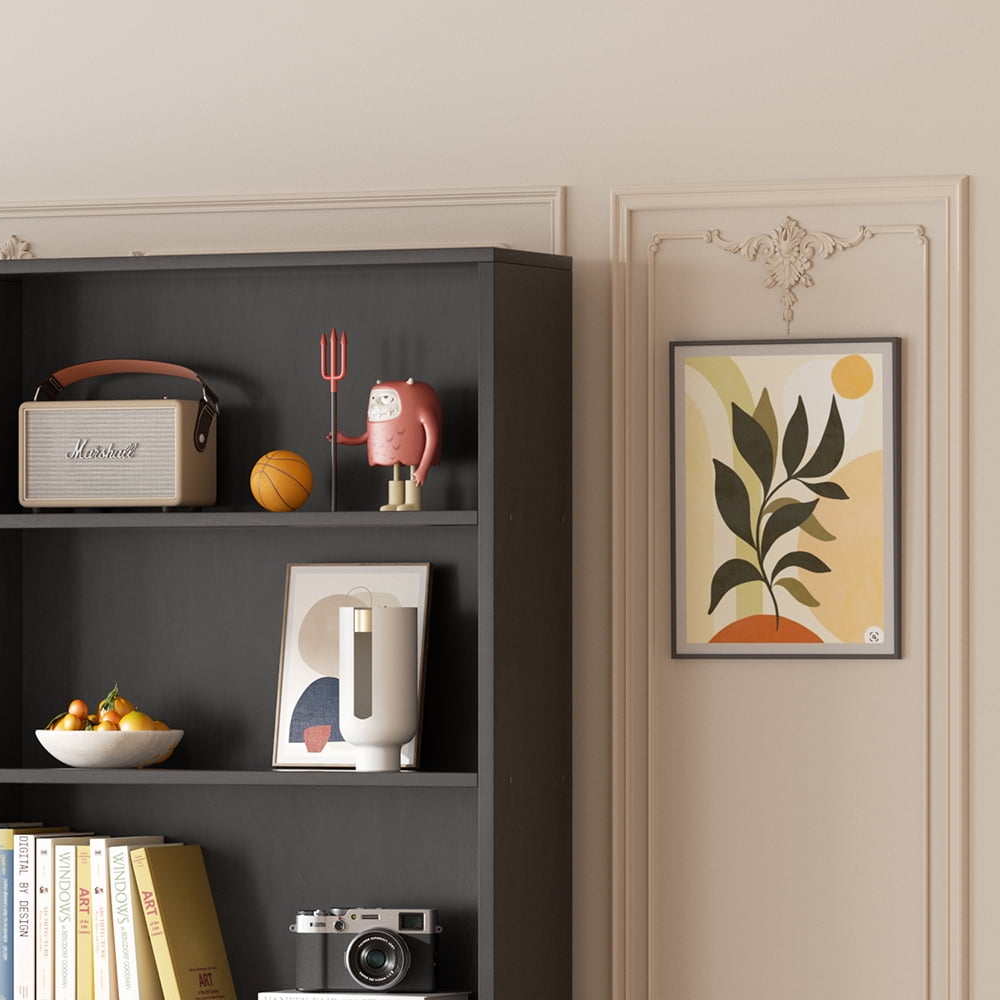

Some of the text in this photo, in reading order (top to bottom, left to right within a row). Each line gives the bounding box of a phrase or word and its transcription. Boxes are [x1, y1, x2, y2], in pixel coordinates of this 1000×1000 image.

[65, 438, 139, 460] Marshall
[18, 835, 29, 938] DIGITAL BY DESIGN
[58, 851, 71, 923] WINDOWS
[112, 852, 130, 925] WINDOWS
[79, 888, 90, 915] ART
[142, 890, 158, 916] ART
[198, 972, 214, 987] ART
